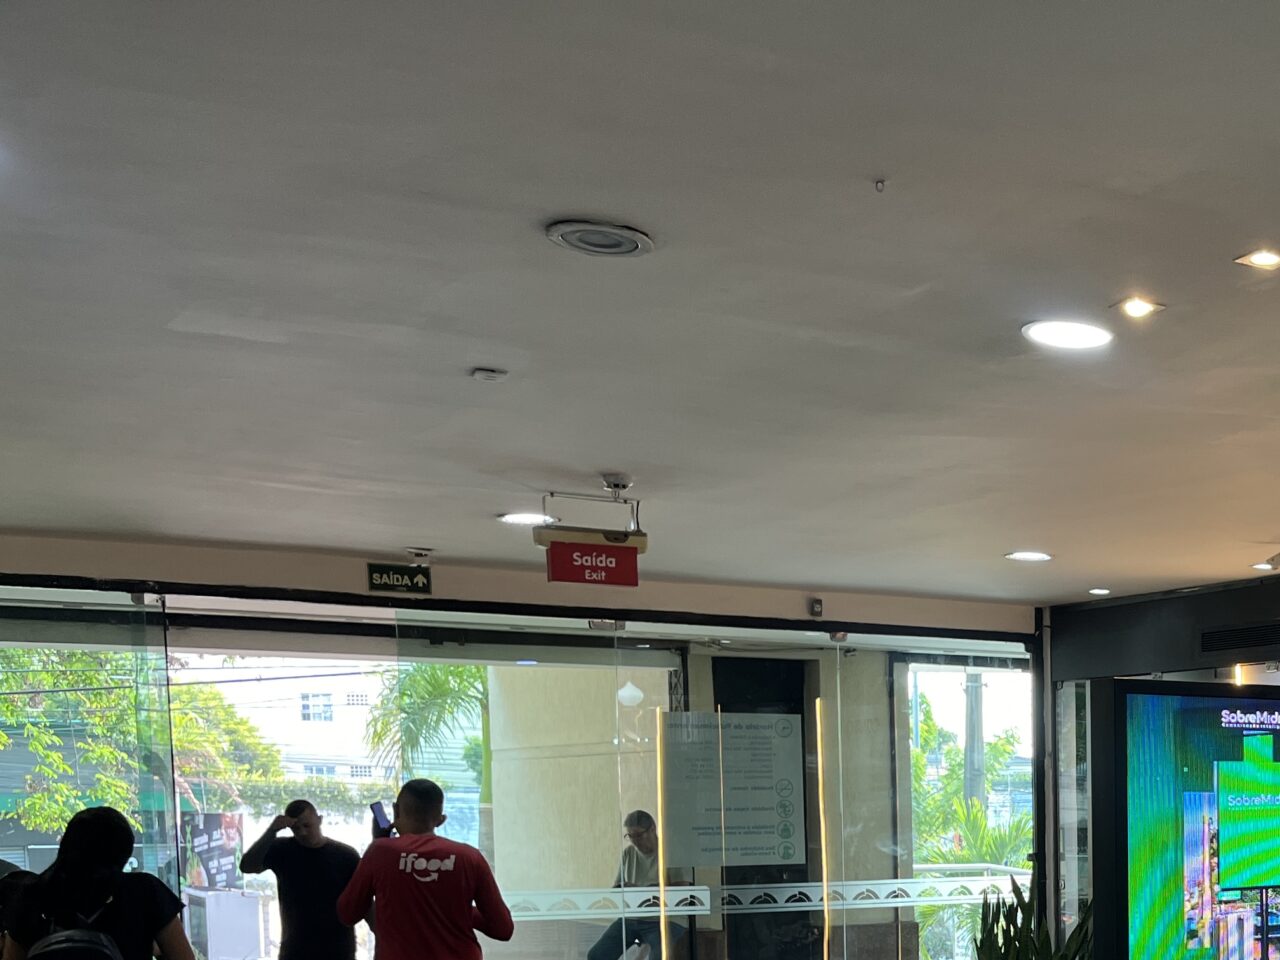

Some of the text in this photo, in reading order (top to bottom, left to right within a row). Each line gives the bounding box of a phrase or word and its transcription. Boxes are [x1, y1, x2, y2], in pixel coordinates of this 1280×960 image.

[572, 551, 616, 568] Saída
[372, 571, 411, 586] SAÍDA
[584, 569, 606, 581] Exit
